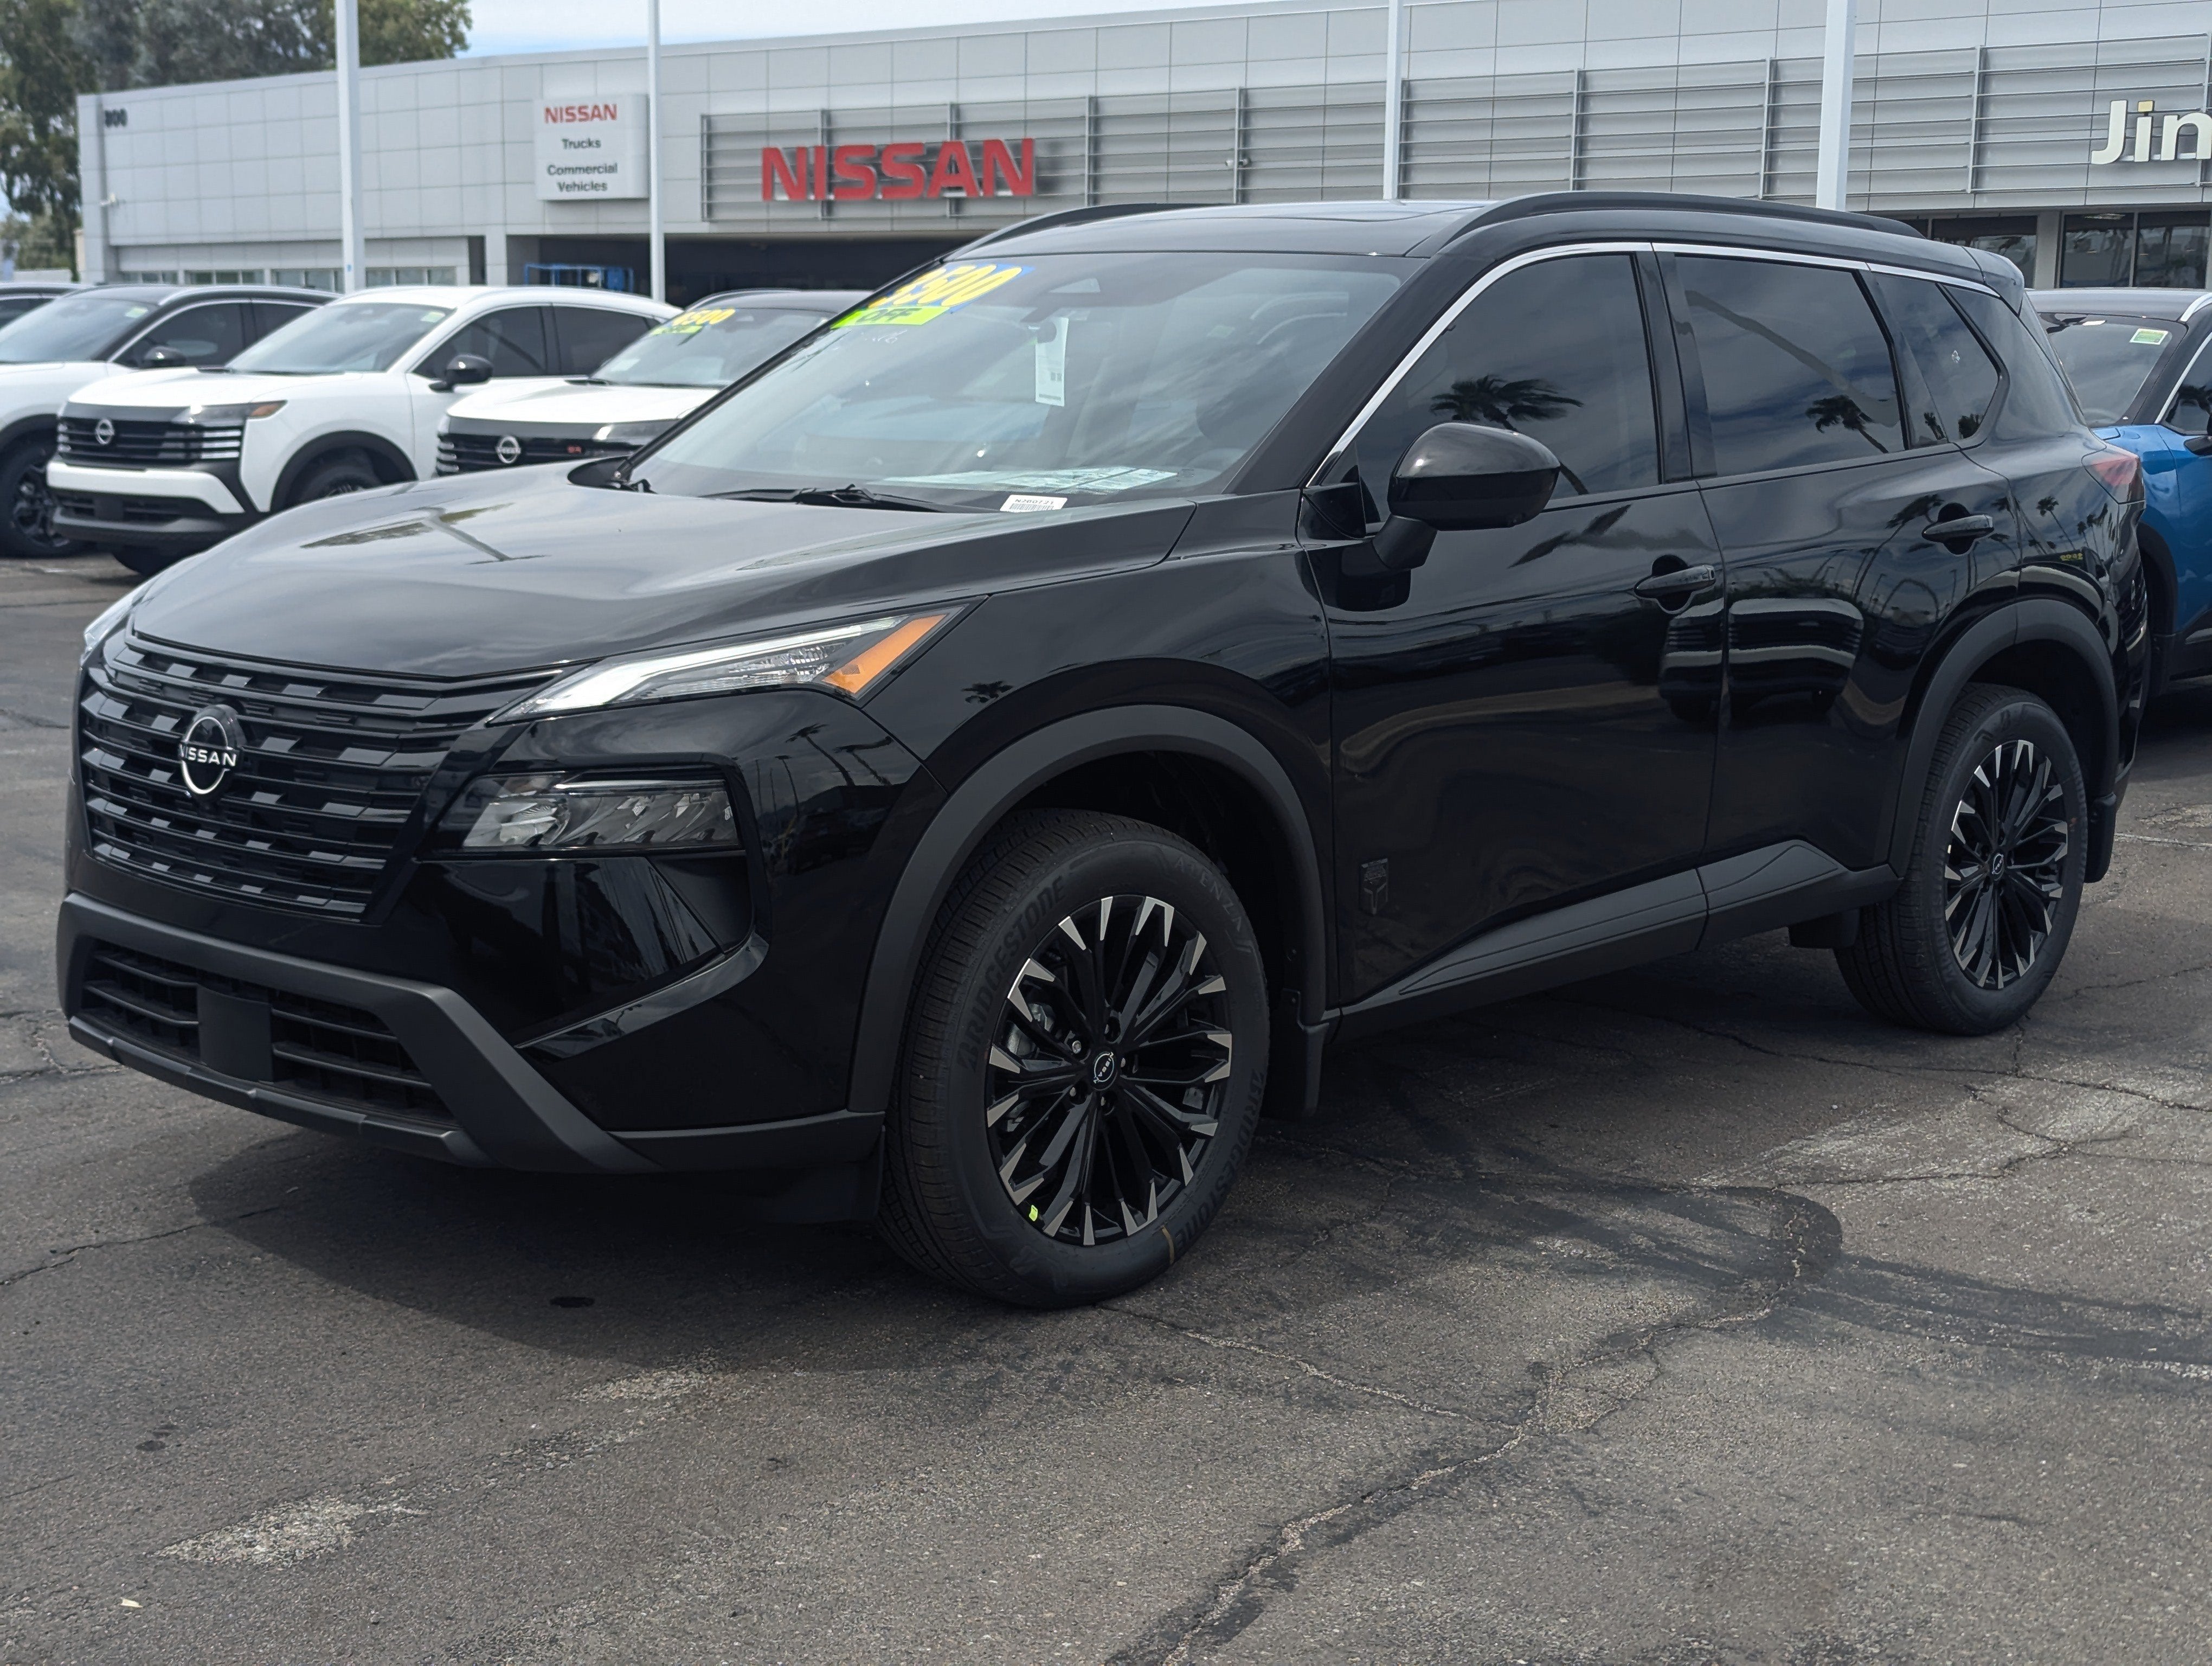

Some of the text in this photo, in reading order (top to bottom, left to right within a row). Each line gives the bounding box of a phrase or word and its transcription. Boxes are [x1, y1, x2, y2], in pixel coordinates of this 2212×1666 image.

[544, 104, 617, 124] NISSAN
[562, 138, 601, 149] Trucks
[547, 162, 618, 175] Commercial
[762, 138, 1033, 201] NISSAN
[557, 181, 608, 192] Vehicles
[856, 307, 922, 324] OFF
[178, 744, 237, 767] NISSAN
[958, 875, 1064, 1073] BRIDGESTONE
